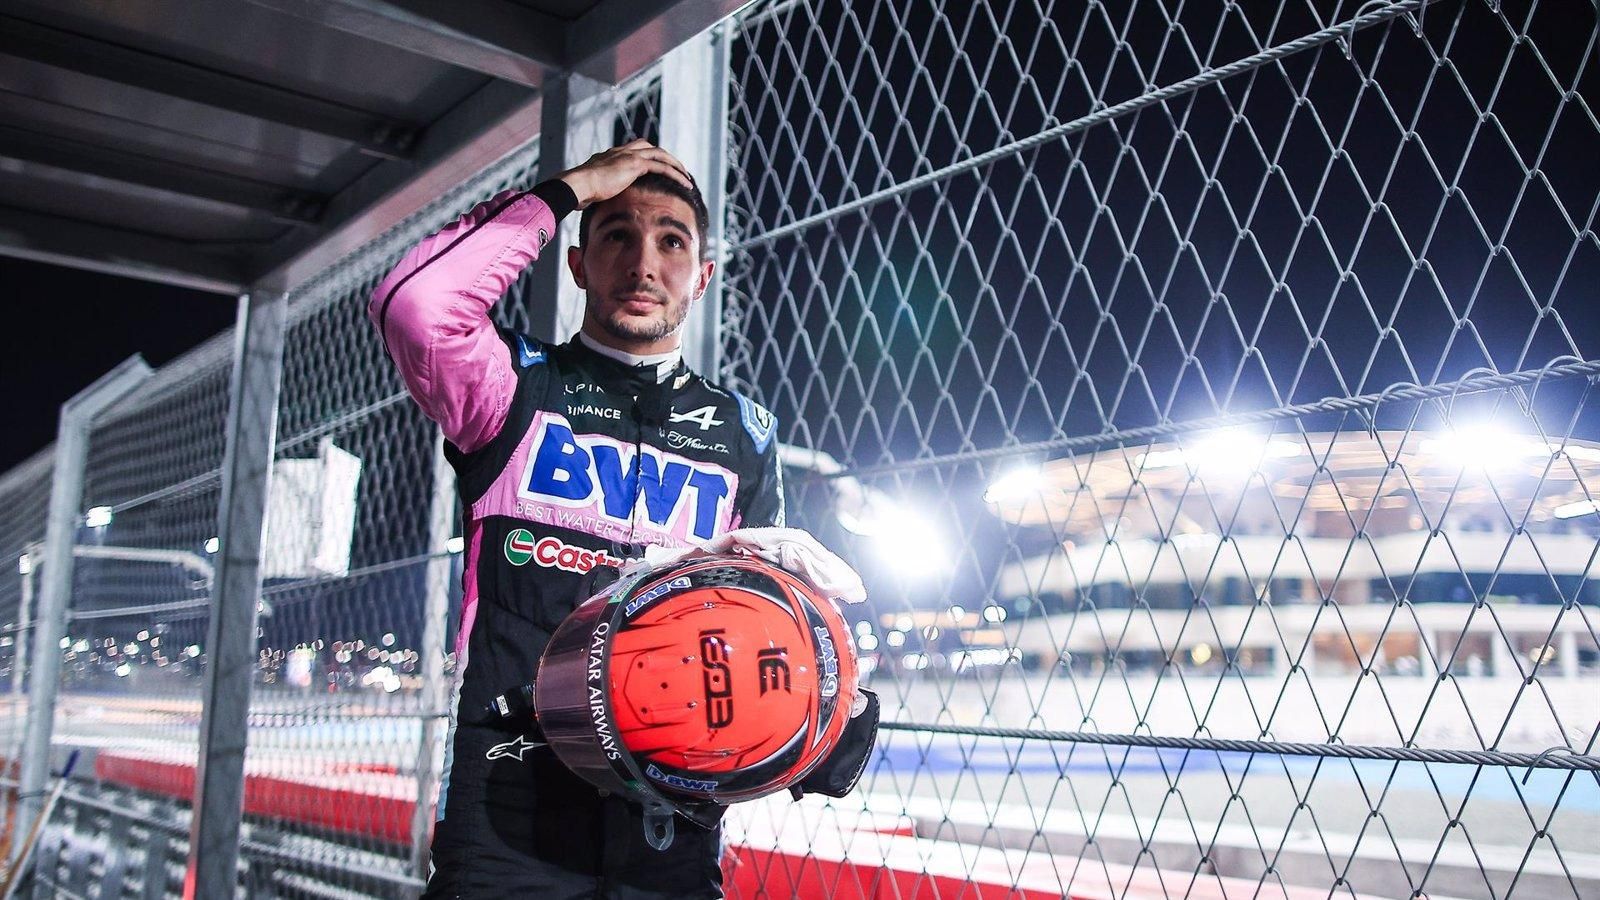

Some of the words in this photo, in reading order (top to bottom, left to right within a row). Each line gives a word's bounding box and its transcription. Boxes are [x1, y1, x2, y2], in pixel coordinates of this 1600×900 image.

[524, 419, 731, 543] BWT
[516, 502, 554, 519] BEST
[557, 510, 614, 536] WATER
[625, 582, 672, 617] BWT
[588, 622, 610, 681] QATAR
[813, 626, 838, 676] BWT
[589, 686, 621, 760] AIRWAYS
[666, 774, 719, 792] BWT
